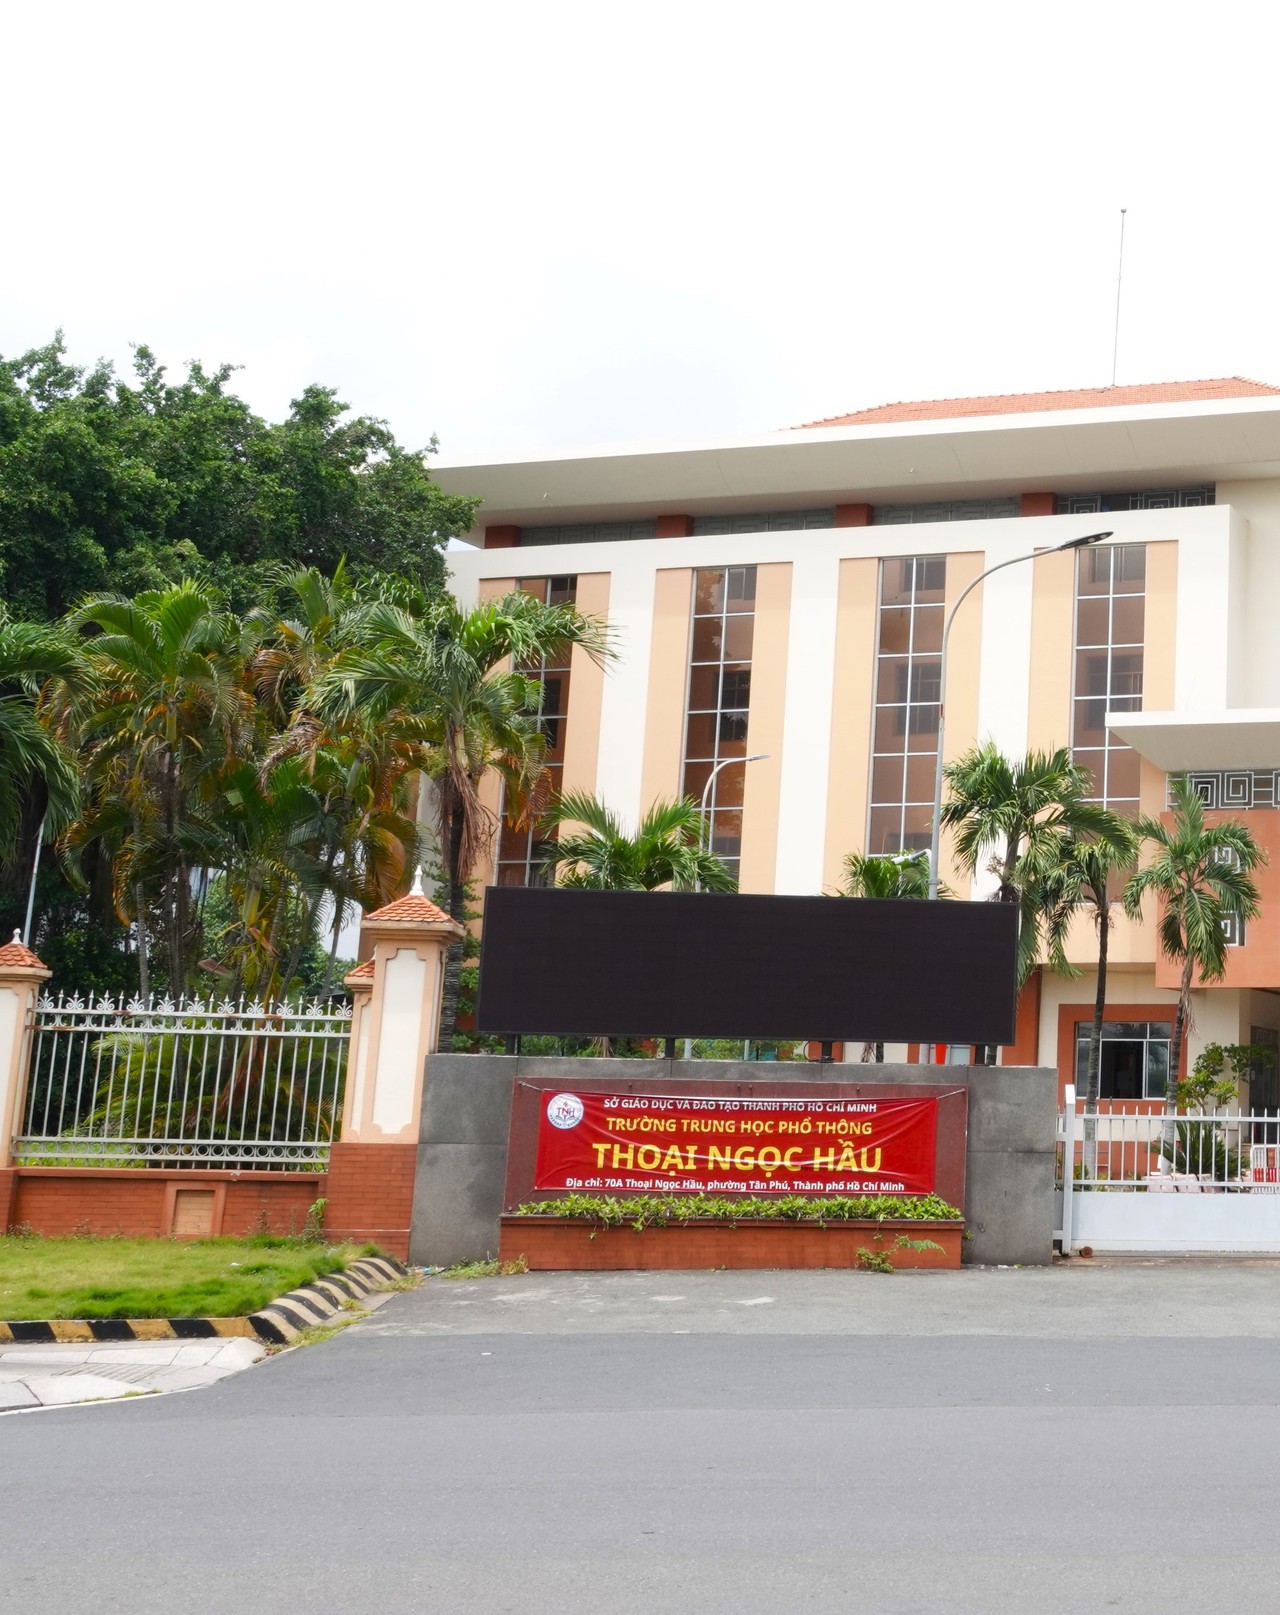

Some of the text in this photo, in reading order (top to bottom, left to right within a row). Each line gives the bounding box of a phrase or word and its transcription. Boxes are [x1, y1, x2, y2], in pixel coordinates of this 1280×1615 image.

[557, 1107, 575, 1116] TNH
[604, 1096, 620, 1108] SỞ
[621, 1098, 649, 1109] GIÁO
[651, 1100, 674, 1111] DỤC
[718, 1101, 740, 1112] TẠO
[826, 1101, 845, 1112] CHÍ
[847, 1103, 877, 1113] MINH
[606, 1115, 873, 1137] TRƯỜNG TRUNG HỌC PHỔ THÔNG
[592, 1138, 882, 1178] THOẠI NGỌC HẦU
[565, 1177, 905, 1192] Địa chỉ: 70A Thoại Ngọc Hầu, phường Tân Phú, Thành phố Hồ Chí Minh
